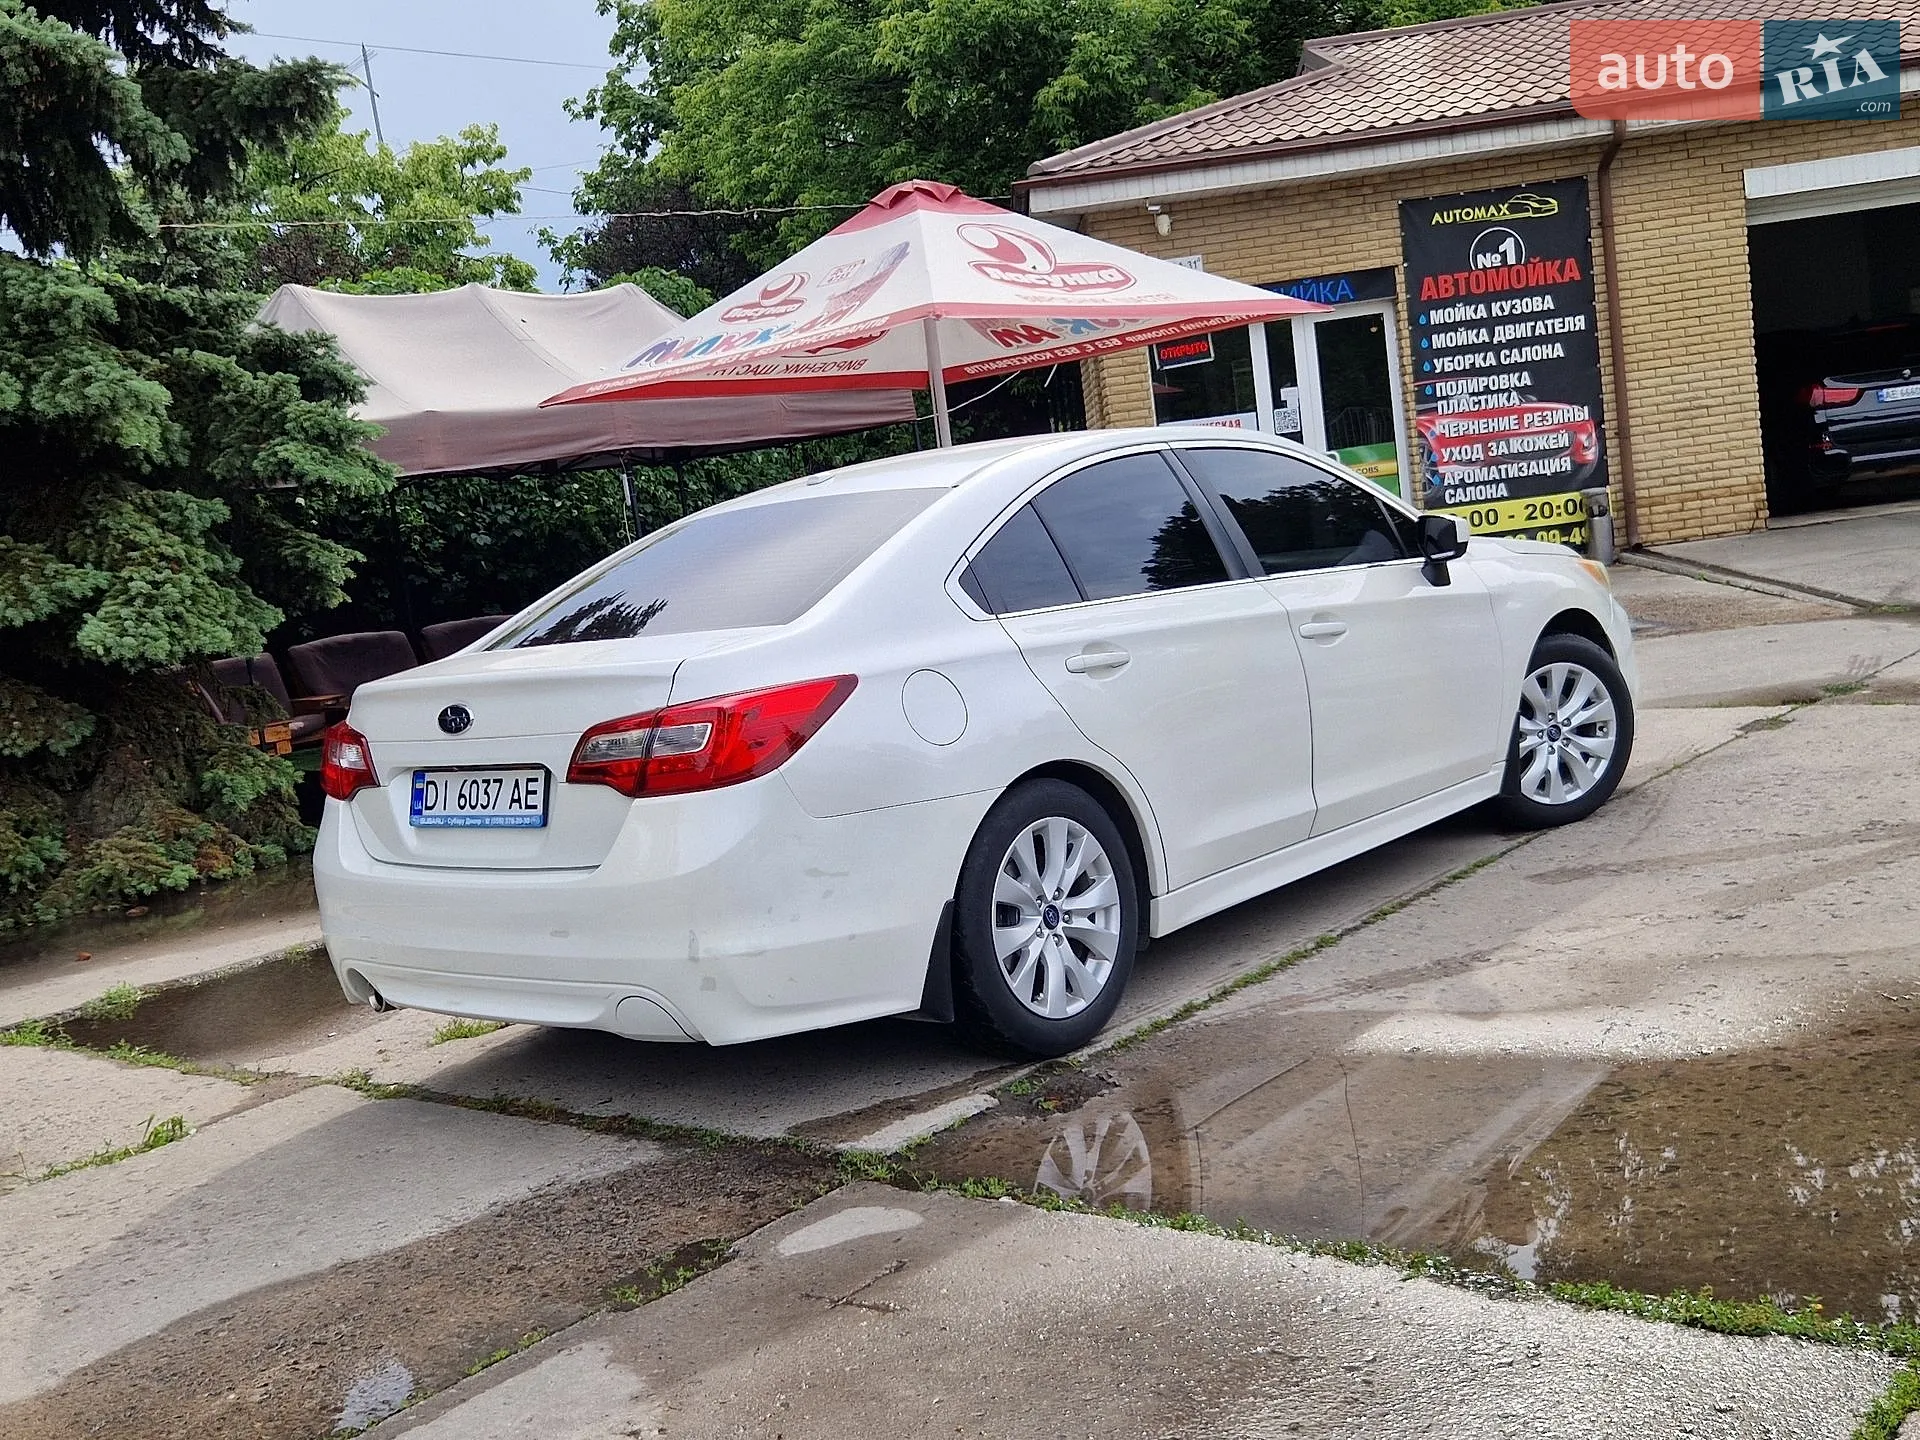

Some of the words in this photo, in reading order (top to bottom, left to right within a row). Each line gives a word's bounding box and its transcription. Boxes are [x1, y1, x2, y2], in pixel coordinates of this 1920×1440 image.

[1431, 203, 1511, 226] AUTOMAX
[1420, 257, 1581, 301] АВТОМОЙКА
[1429, 303, 1488, 326] МОЙКА
[1491, 295, 1555, 317] КУЗОВА
[1431, 326, 1490, 350] МОЙКА
[1492, 315, 1586, 345] ДВИГАТЕЛЯ
[1160, 341, 1209, 360] ОТКРЫТО
[1433, 352, 1497, 374] УБОРКА
[1499, 342, 1565, 365] САЛОНА
[1435, 370, 1532, 398] ПОЛИРОВКА
[1437, 391, 1521, 416] ПЛАСТИКА
[1439, 417, 1520, 438] ЧЕРНЕНИЕ
[1523, 405, 1589, 428] РЕЗИНЫ
[1440, 443, 1485, 463] УХОД
[1487, 440, 1510, 457] ЗА
[1510, 430, 1570, 454] КОЖЕЙ
[1443, 456, 1572, 486] АРОМАТИЗАЦИЯ
[1444, 482, 1509, 504] САЛОНА
[424, 780, 449, 811] DI
[457, 778, 504, 810] 6037
[509, 777, 539, 810] AE
